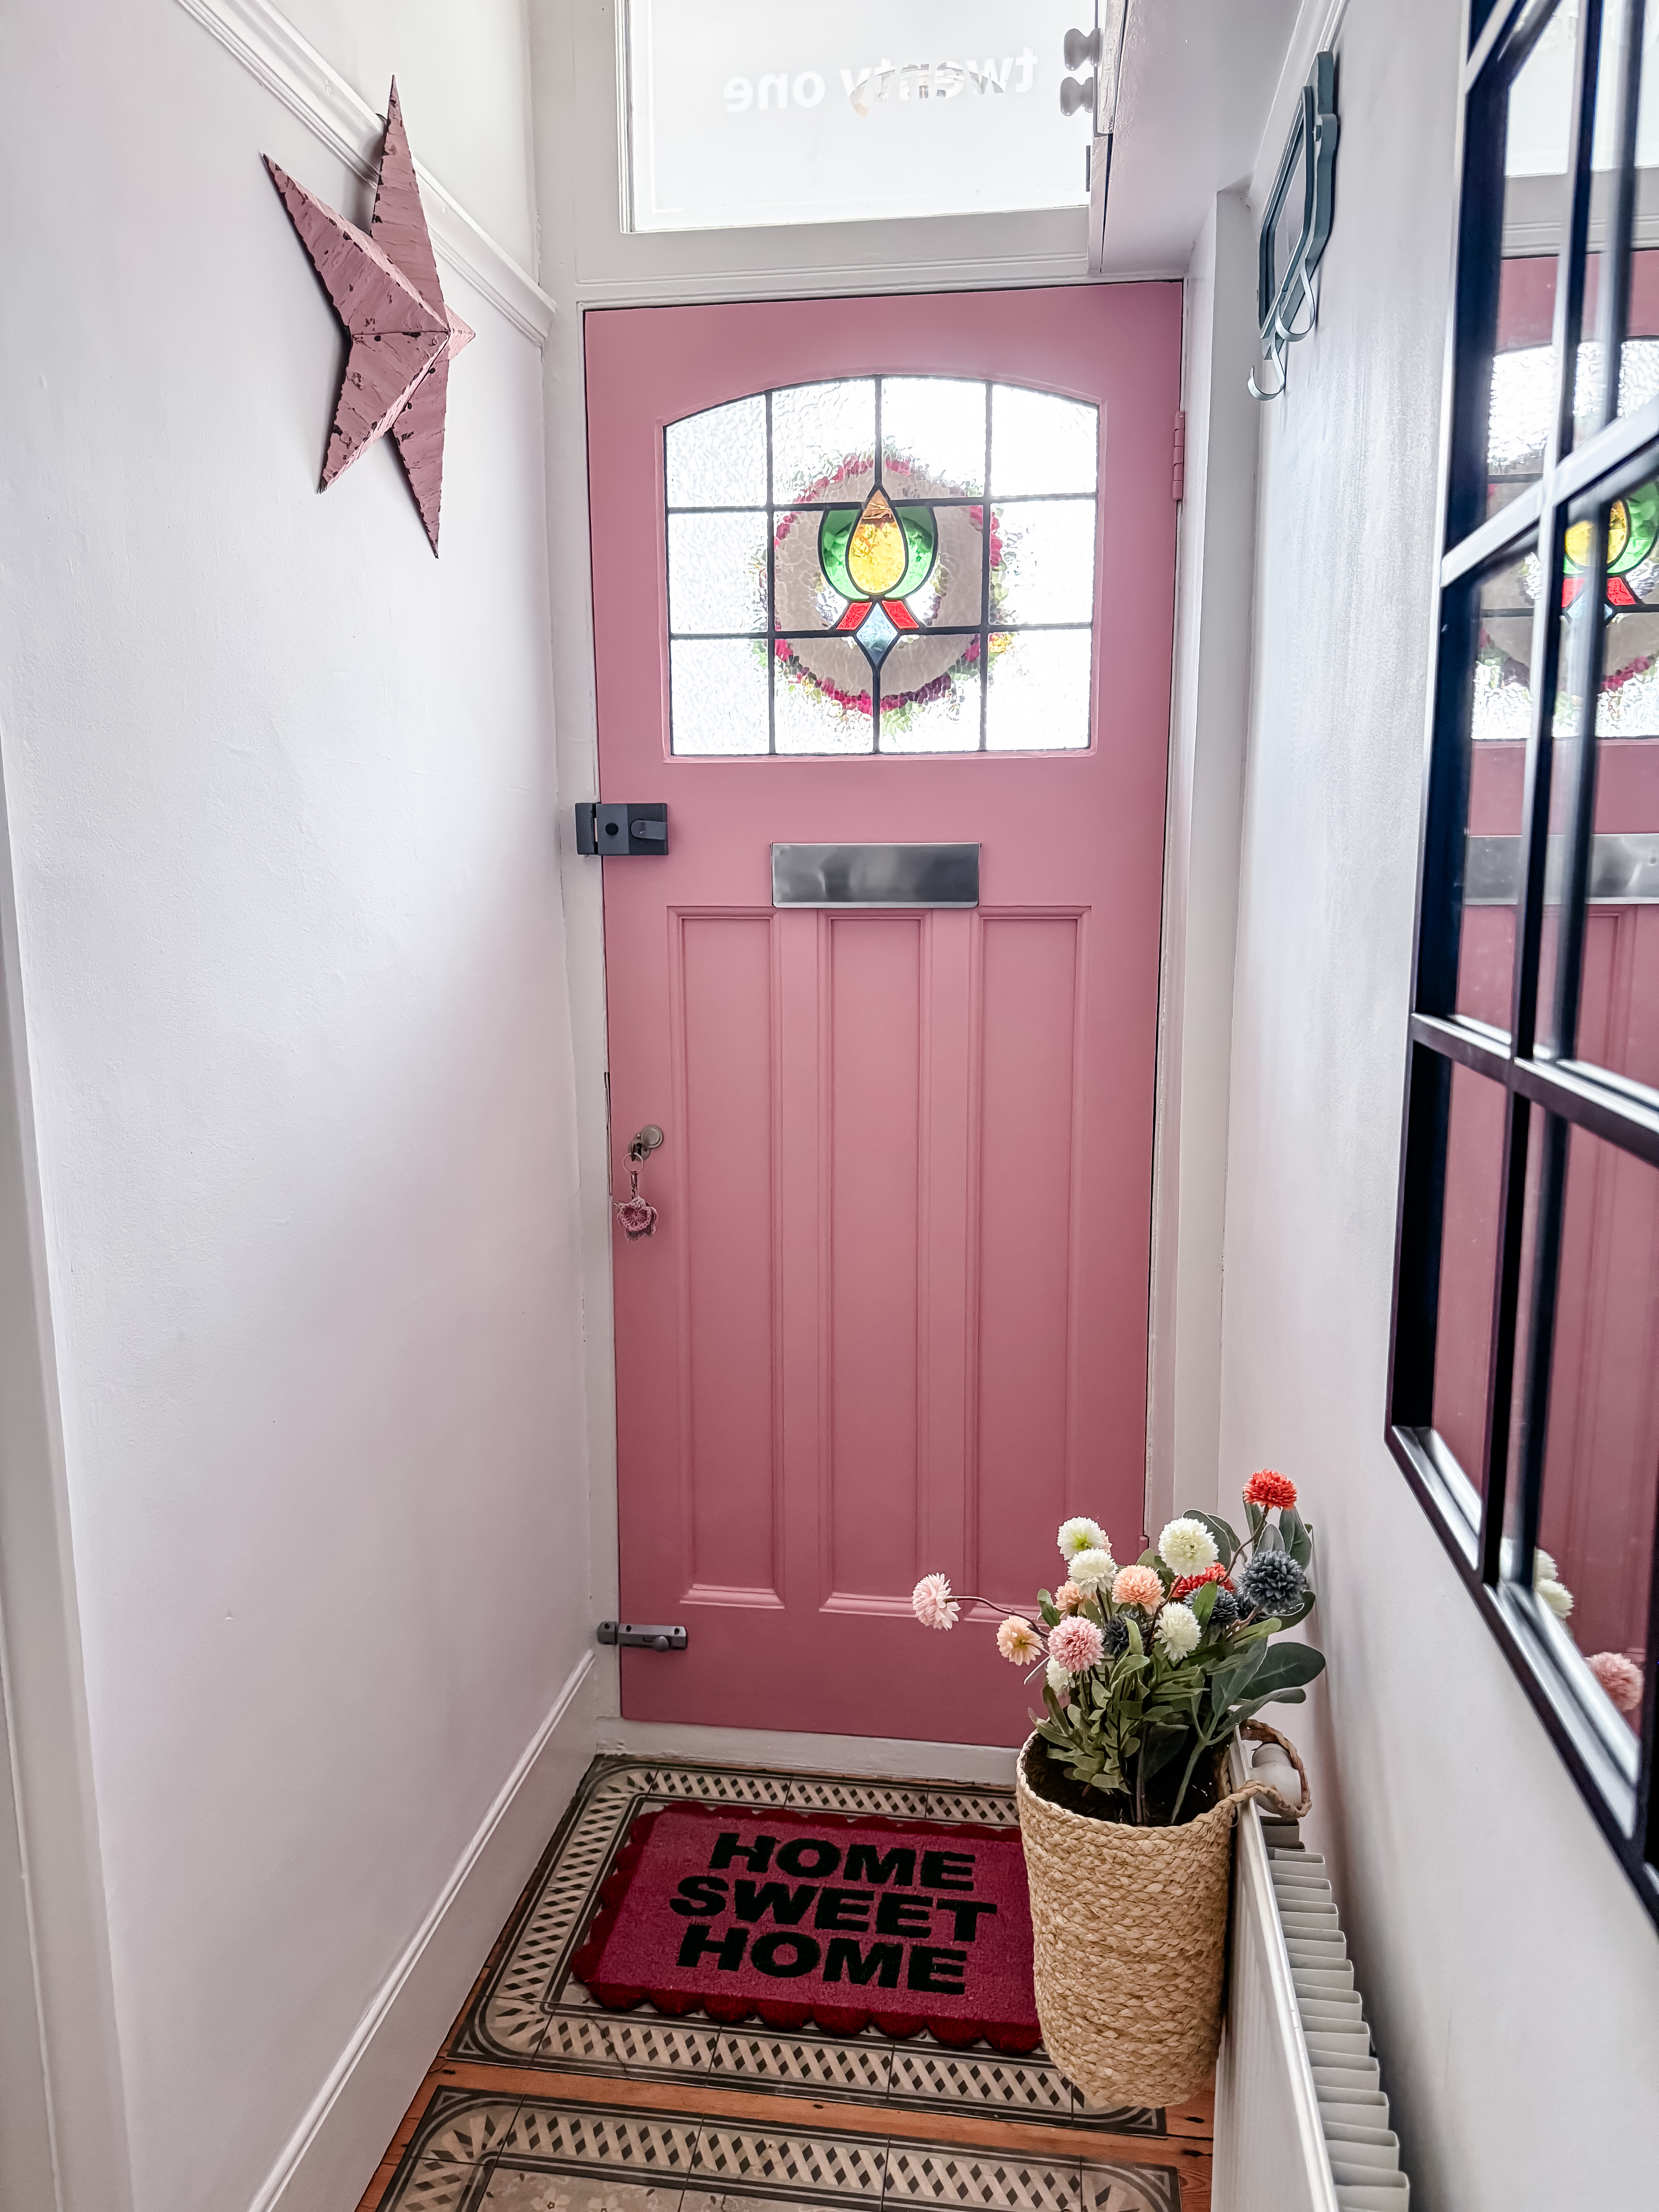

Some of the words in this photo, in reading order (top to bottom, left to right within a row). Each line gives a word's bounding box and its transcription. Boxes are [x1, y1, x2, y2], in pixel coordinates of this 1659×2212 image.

[708, 1832, 975, 1891] HOME
[670, 1875, 998, 1942] SWEET
[675, 1924, 967, 1995] HOME
